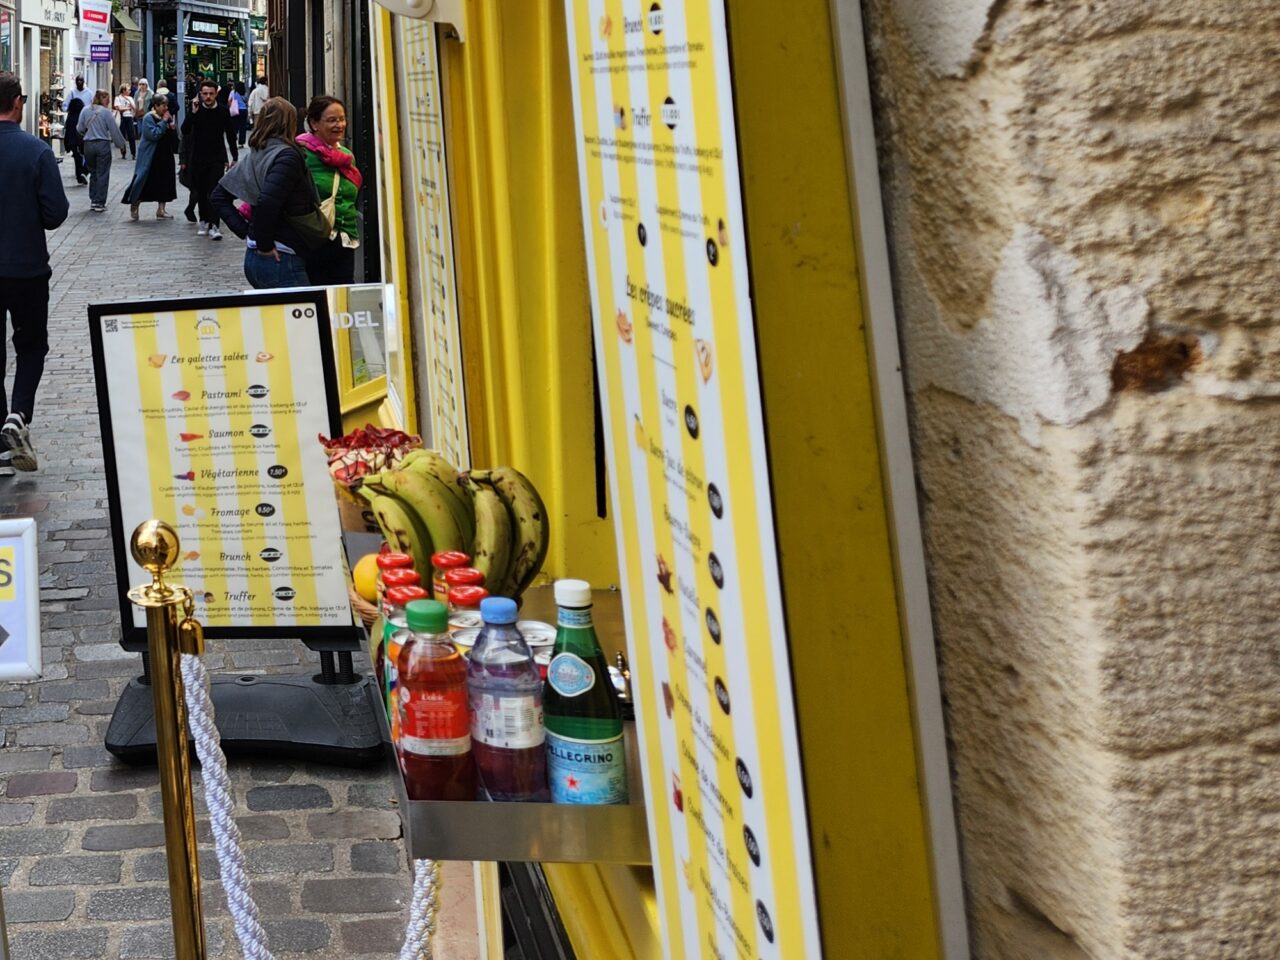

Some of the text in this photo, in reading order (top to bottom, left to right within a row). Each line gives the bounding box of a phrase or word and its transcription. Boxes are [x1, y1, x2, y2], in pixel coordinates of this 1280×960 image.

[171, 352, 249, 366] Les galettes salées
[201, 389, 242, 400] Pastrami
[208, 429, 244, 439] Saumon
[201, 468, 259, 480] Végétarienne
[211, 508, 250, 518] Fromage
[220, 552, 251, 561] Brunch
[224, 591, 256, 603] Truffer
